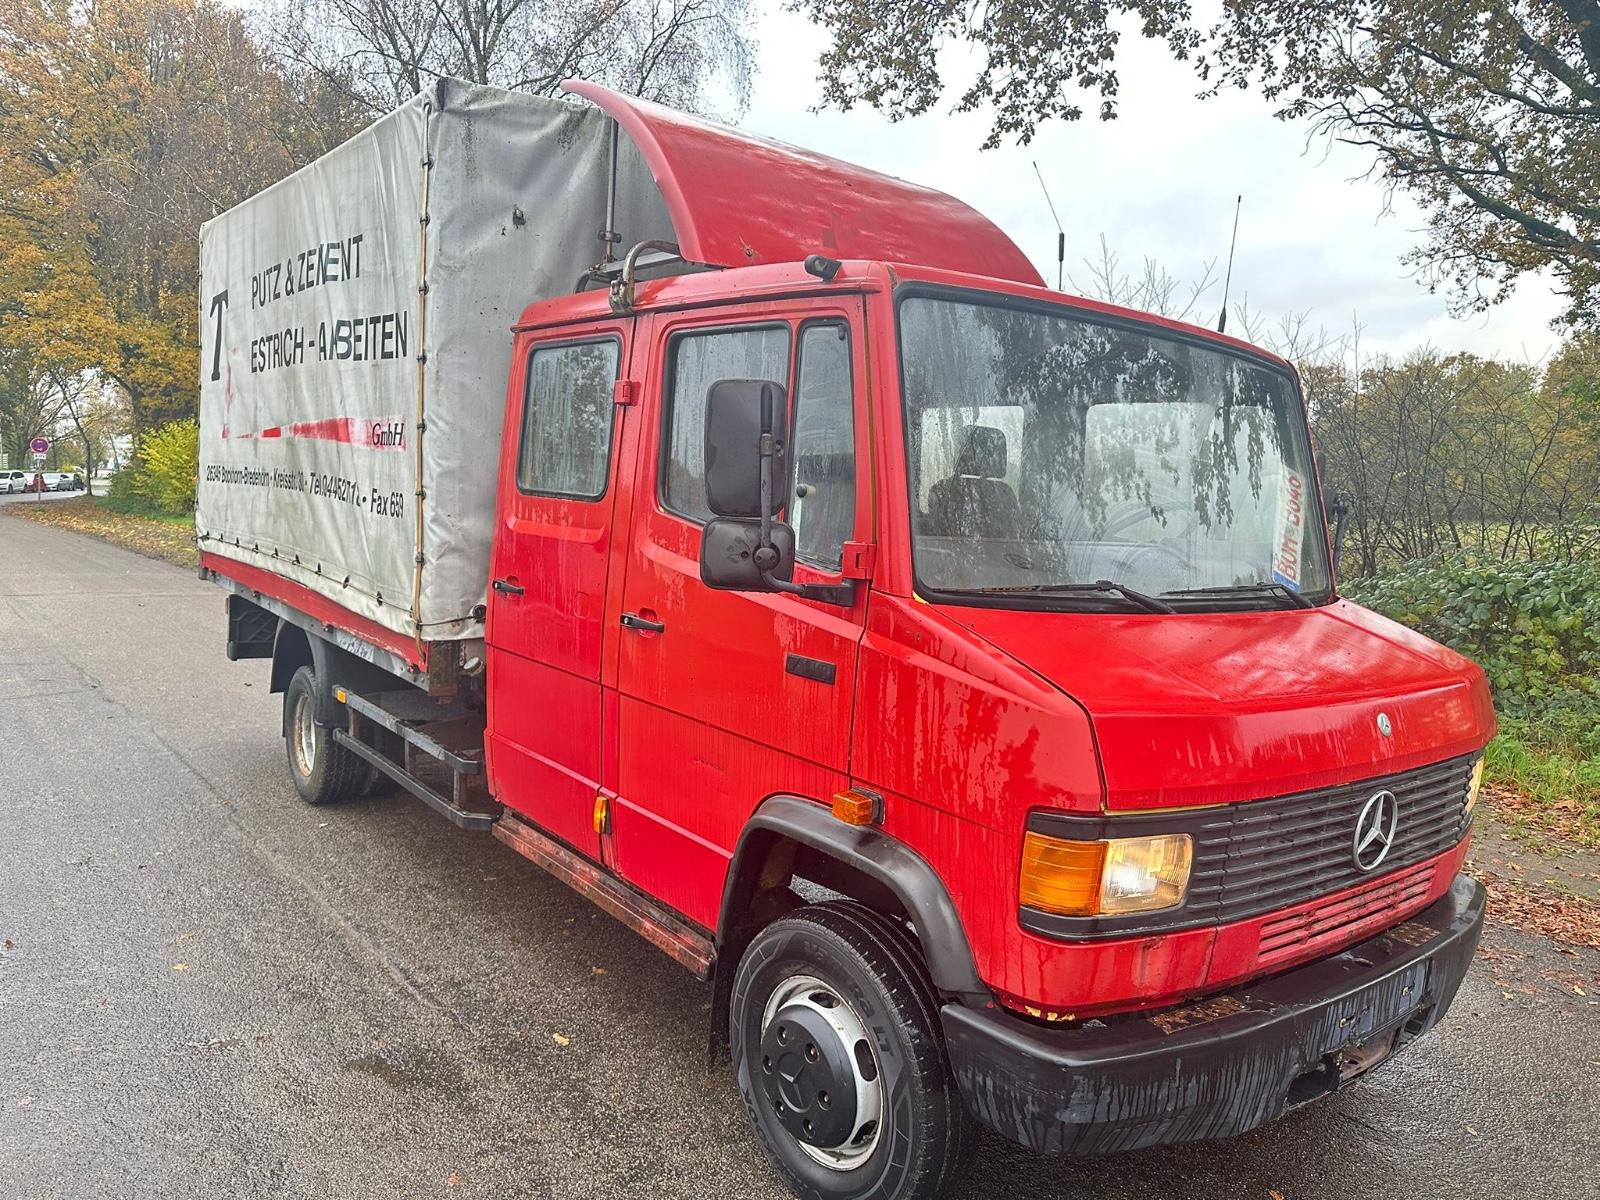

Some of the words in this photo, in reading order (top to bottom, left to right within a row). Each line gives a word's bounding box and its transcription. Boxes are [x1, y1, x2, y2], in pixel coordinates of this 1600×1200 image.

[251, 263, 282, 310] PUTZ
[285, 258, 295, 297] &
[251, 327, 304, 374] ESTRICH
[372, 422, 404, 446] GmbH
[370, 487, 388, 516] Fax
[390, 491, 404, 519] 659
[871, 1023, 894, 1057] LT
